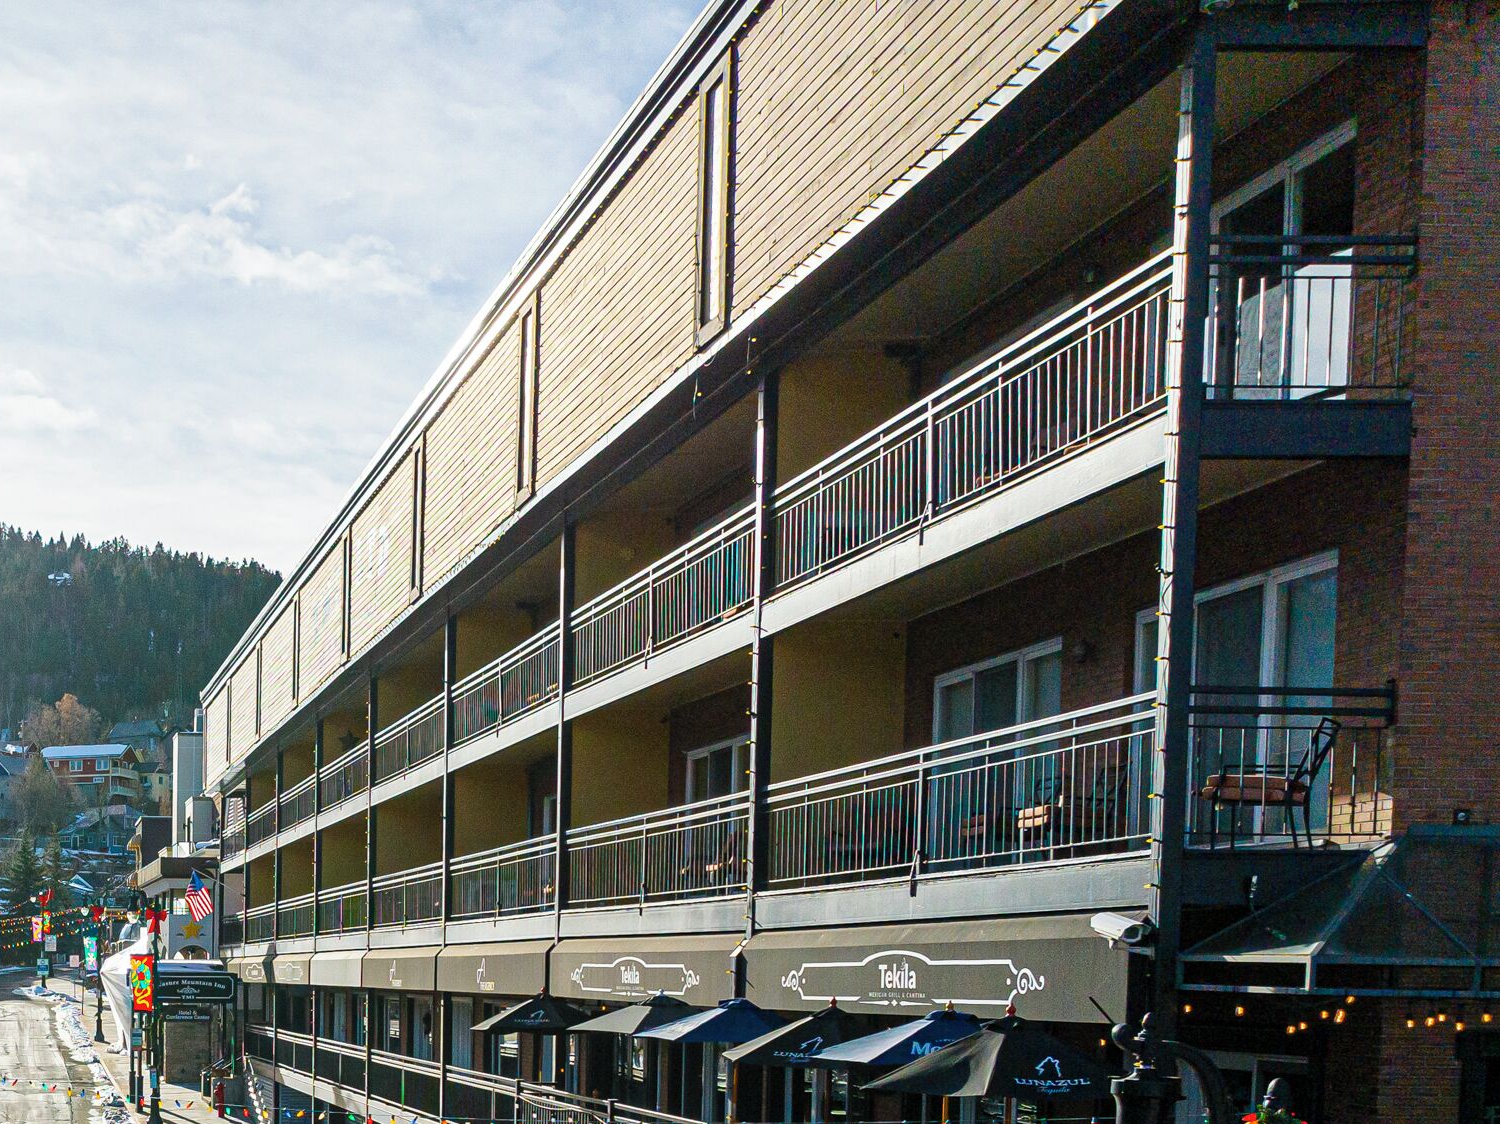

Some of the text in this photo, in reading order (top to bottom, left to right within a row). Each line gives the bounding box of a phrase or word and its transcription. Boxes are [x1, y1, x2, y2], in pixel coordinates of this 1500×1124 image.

[619, 965, 640, 984] Tekila
[878, 961, 917, 990] Tekila
[1013, 1077, 1091, 1086] LUNAZUL
